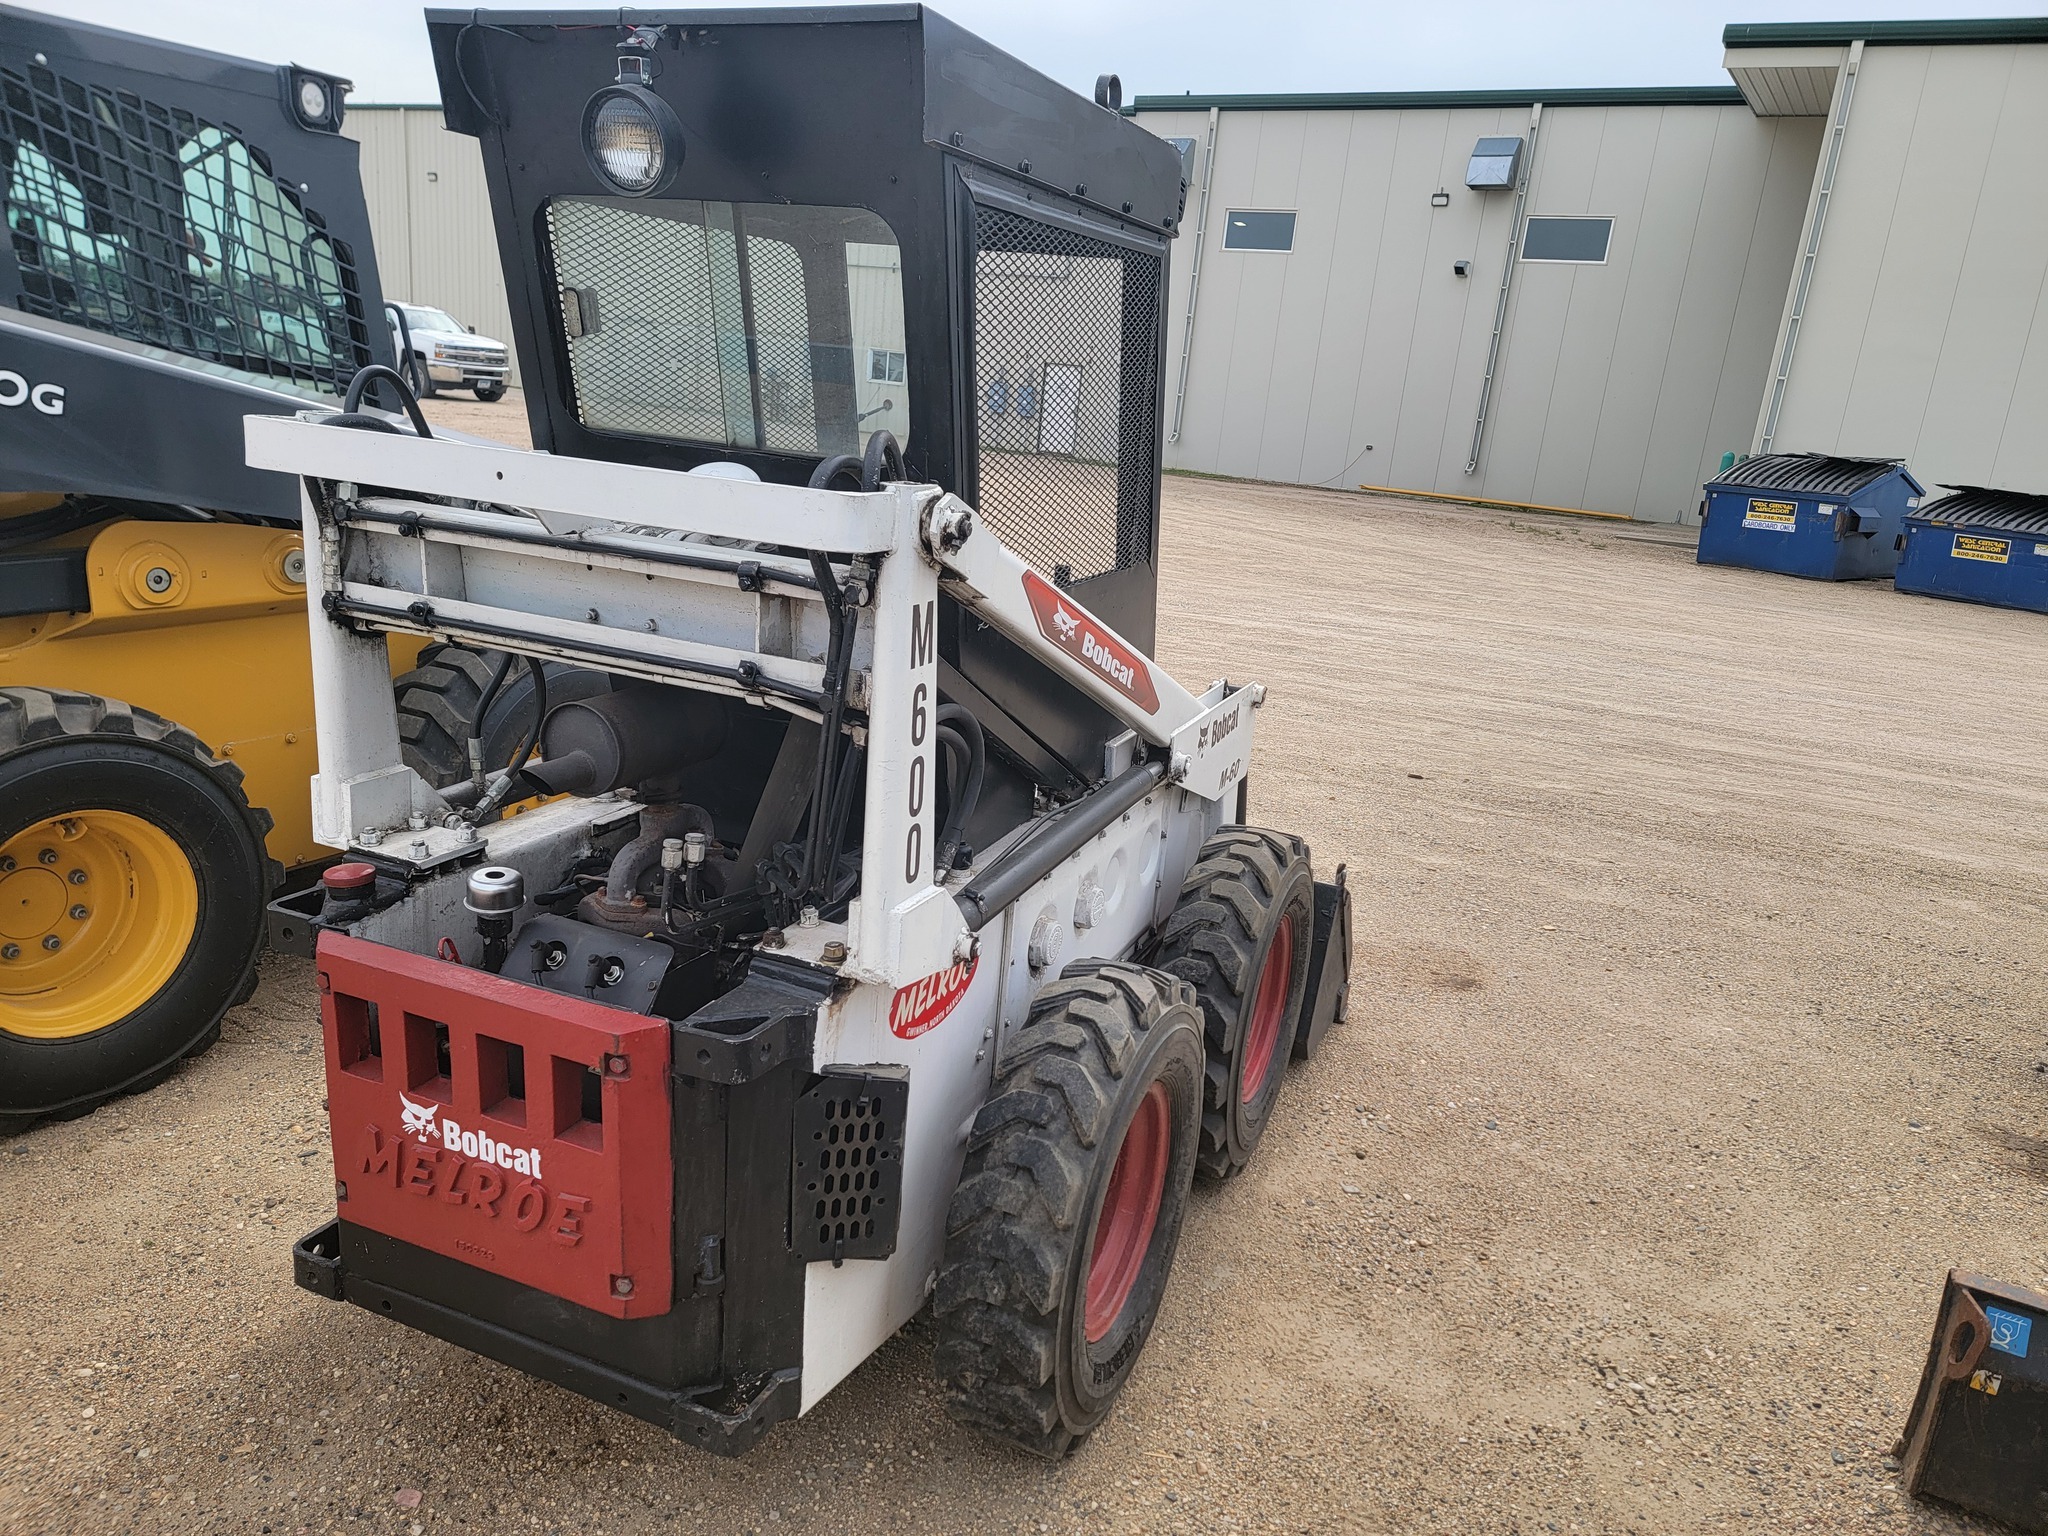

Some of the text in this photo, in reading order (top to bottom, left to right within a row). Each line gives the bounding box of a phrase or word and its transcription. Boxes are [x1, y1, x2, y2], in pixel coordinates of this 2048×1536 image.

[1743, 520, 1778, 530] CARDBOARD
[1082, 631, 1134, 689] Bobcat
[1211, 703, 1239, 748] Bobcat
[945, 988, 965, 1015] DAKOTA
[443, 1118, 542, 1179] Bobcat
[357, 1123, 593, 1247] MELROE
